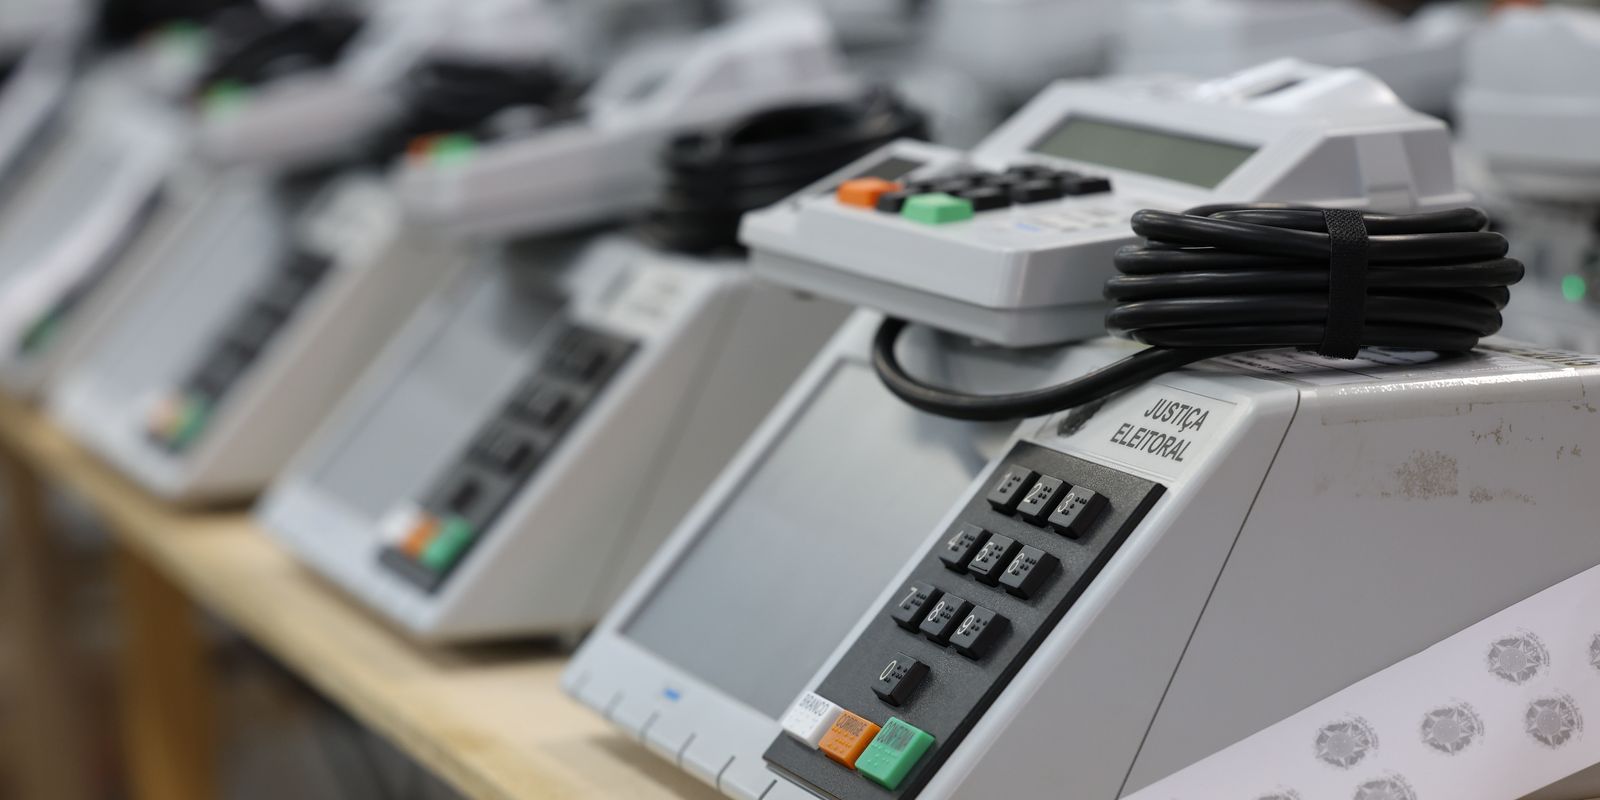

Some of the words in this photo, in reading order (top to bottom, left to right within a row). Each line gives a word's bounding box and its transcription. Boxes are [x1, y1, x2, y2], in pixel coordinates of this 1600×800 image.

[1144, 398, 1209, 432] JUSTIÇA
[1110, 423, 1191, 462] ELEITORAL
[996, 471, 1010, 490] 1
[1023, 482, 1042, 504] 2
[1057, 493, 1073, 513] 3
[947, 530, 963, 551] 4
[979, 542, 994, 562] 5
[1007, 553, 1025, 573] 6
[898, 587, 917, 607] 7
[927, 601, 944, 622] 8
[957, 614, 975, 635] 9
[879, 660, 896, 681] 0
